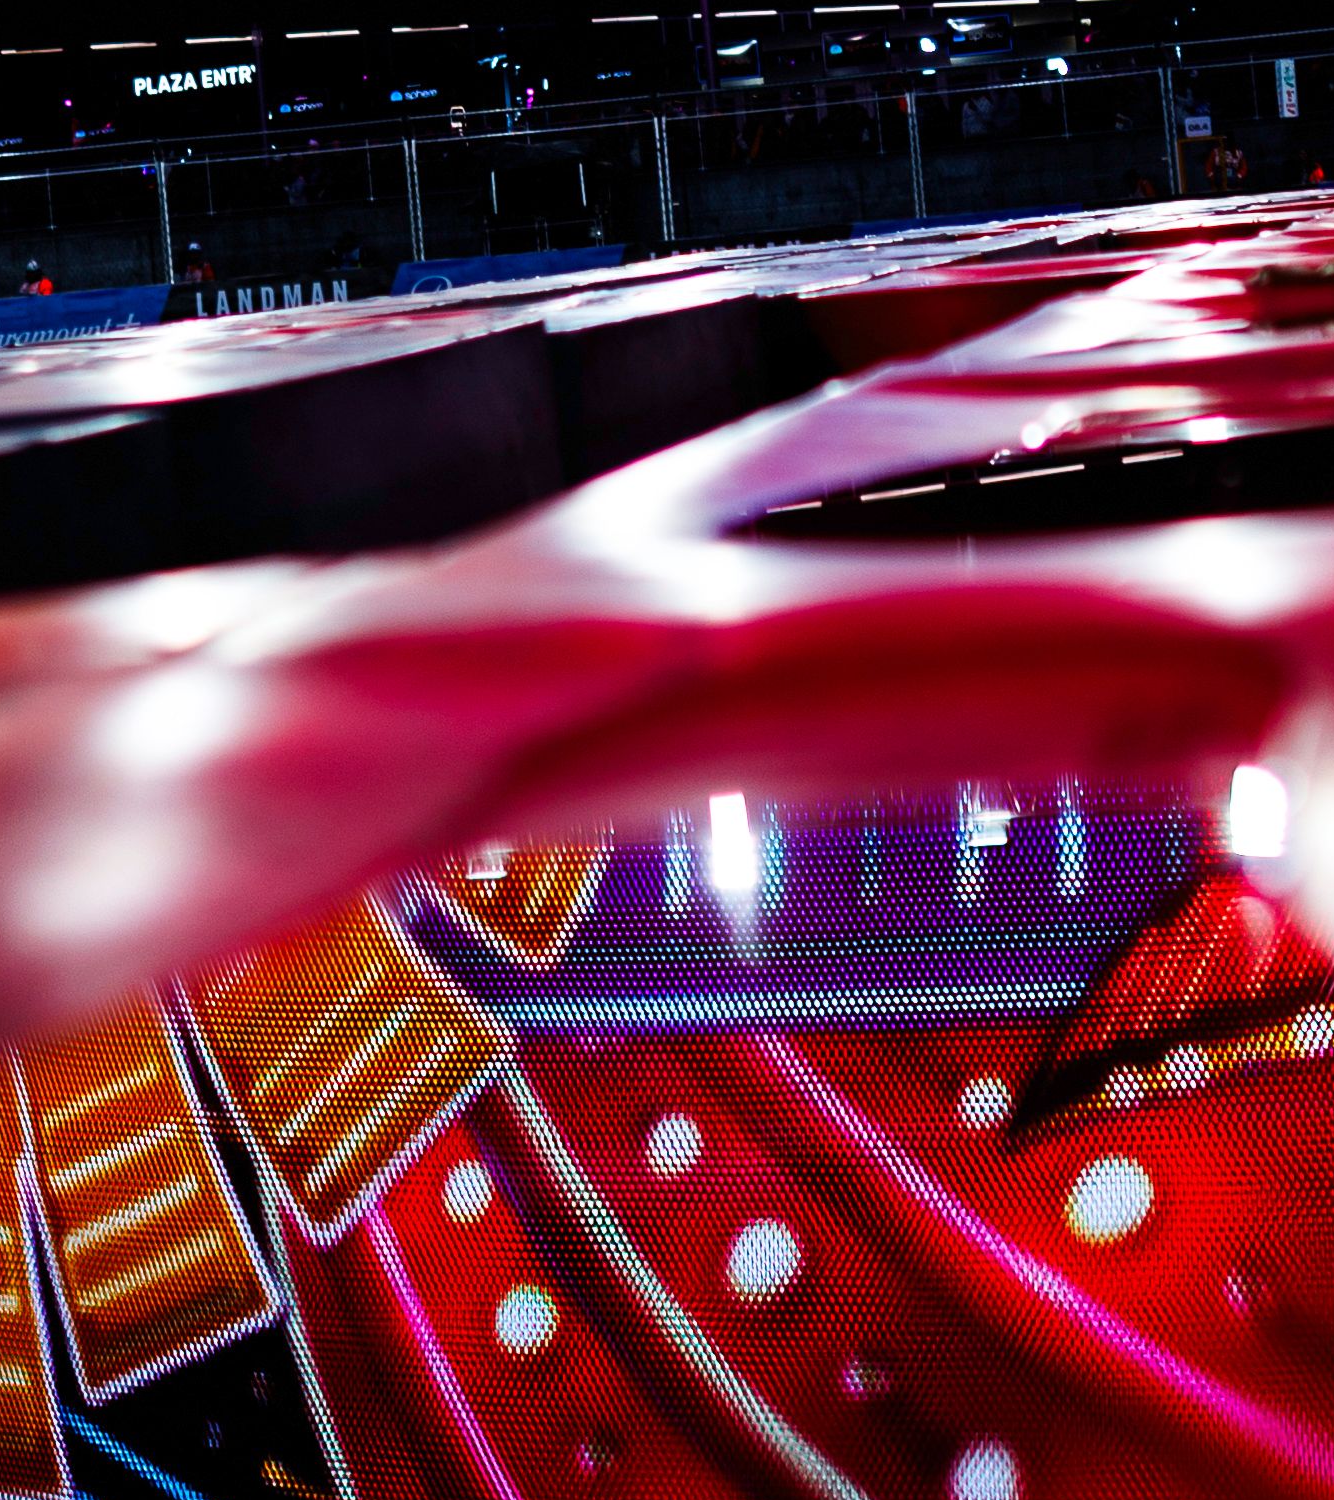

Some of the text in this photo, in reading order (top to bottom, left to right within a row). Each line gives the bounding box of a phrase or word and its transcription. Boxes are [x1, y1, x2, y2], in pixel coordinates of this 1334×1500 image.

[134, 63, 257, 97] PLAZA ENTR
[196, 279, 349, 318] LANDMAN
